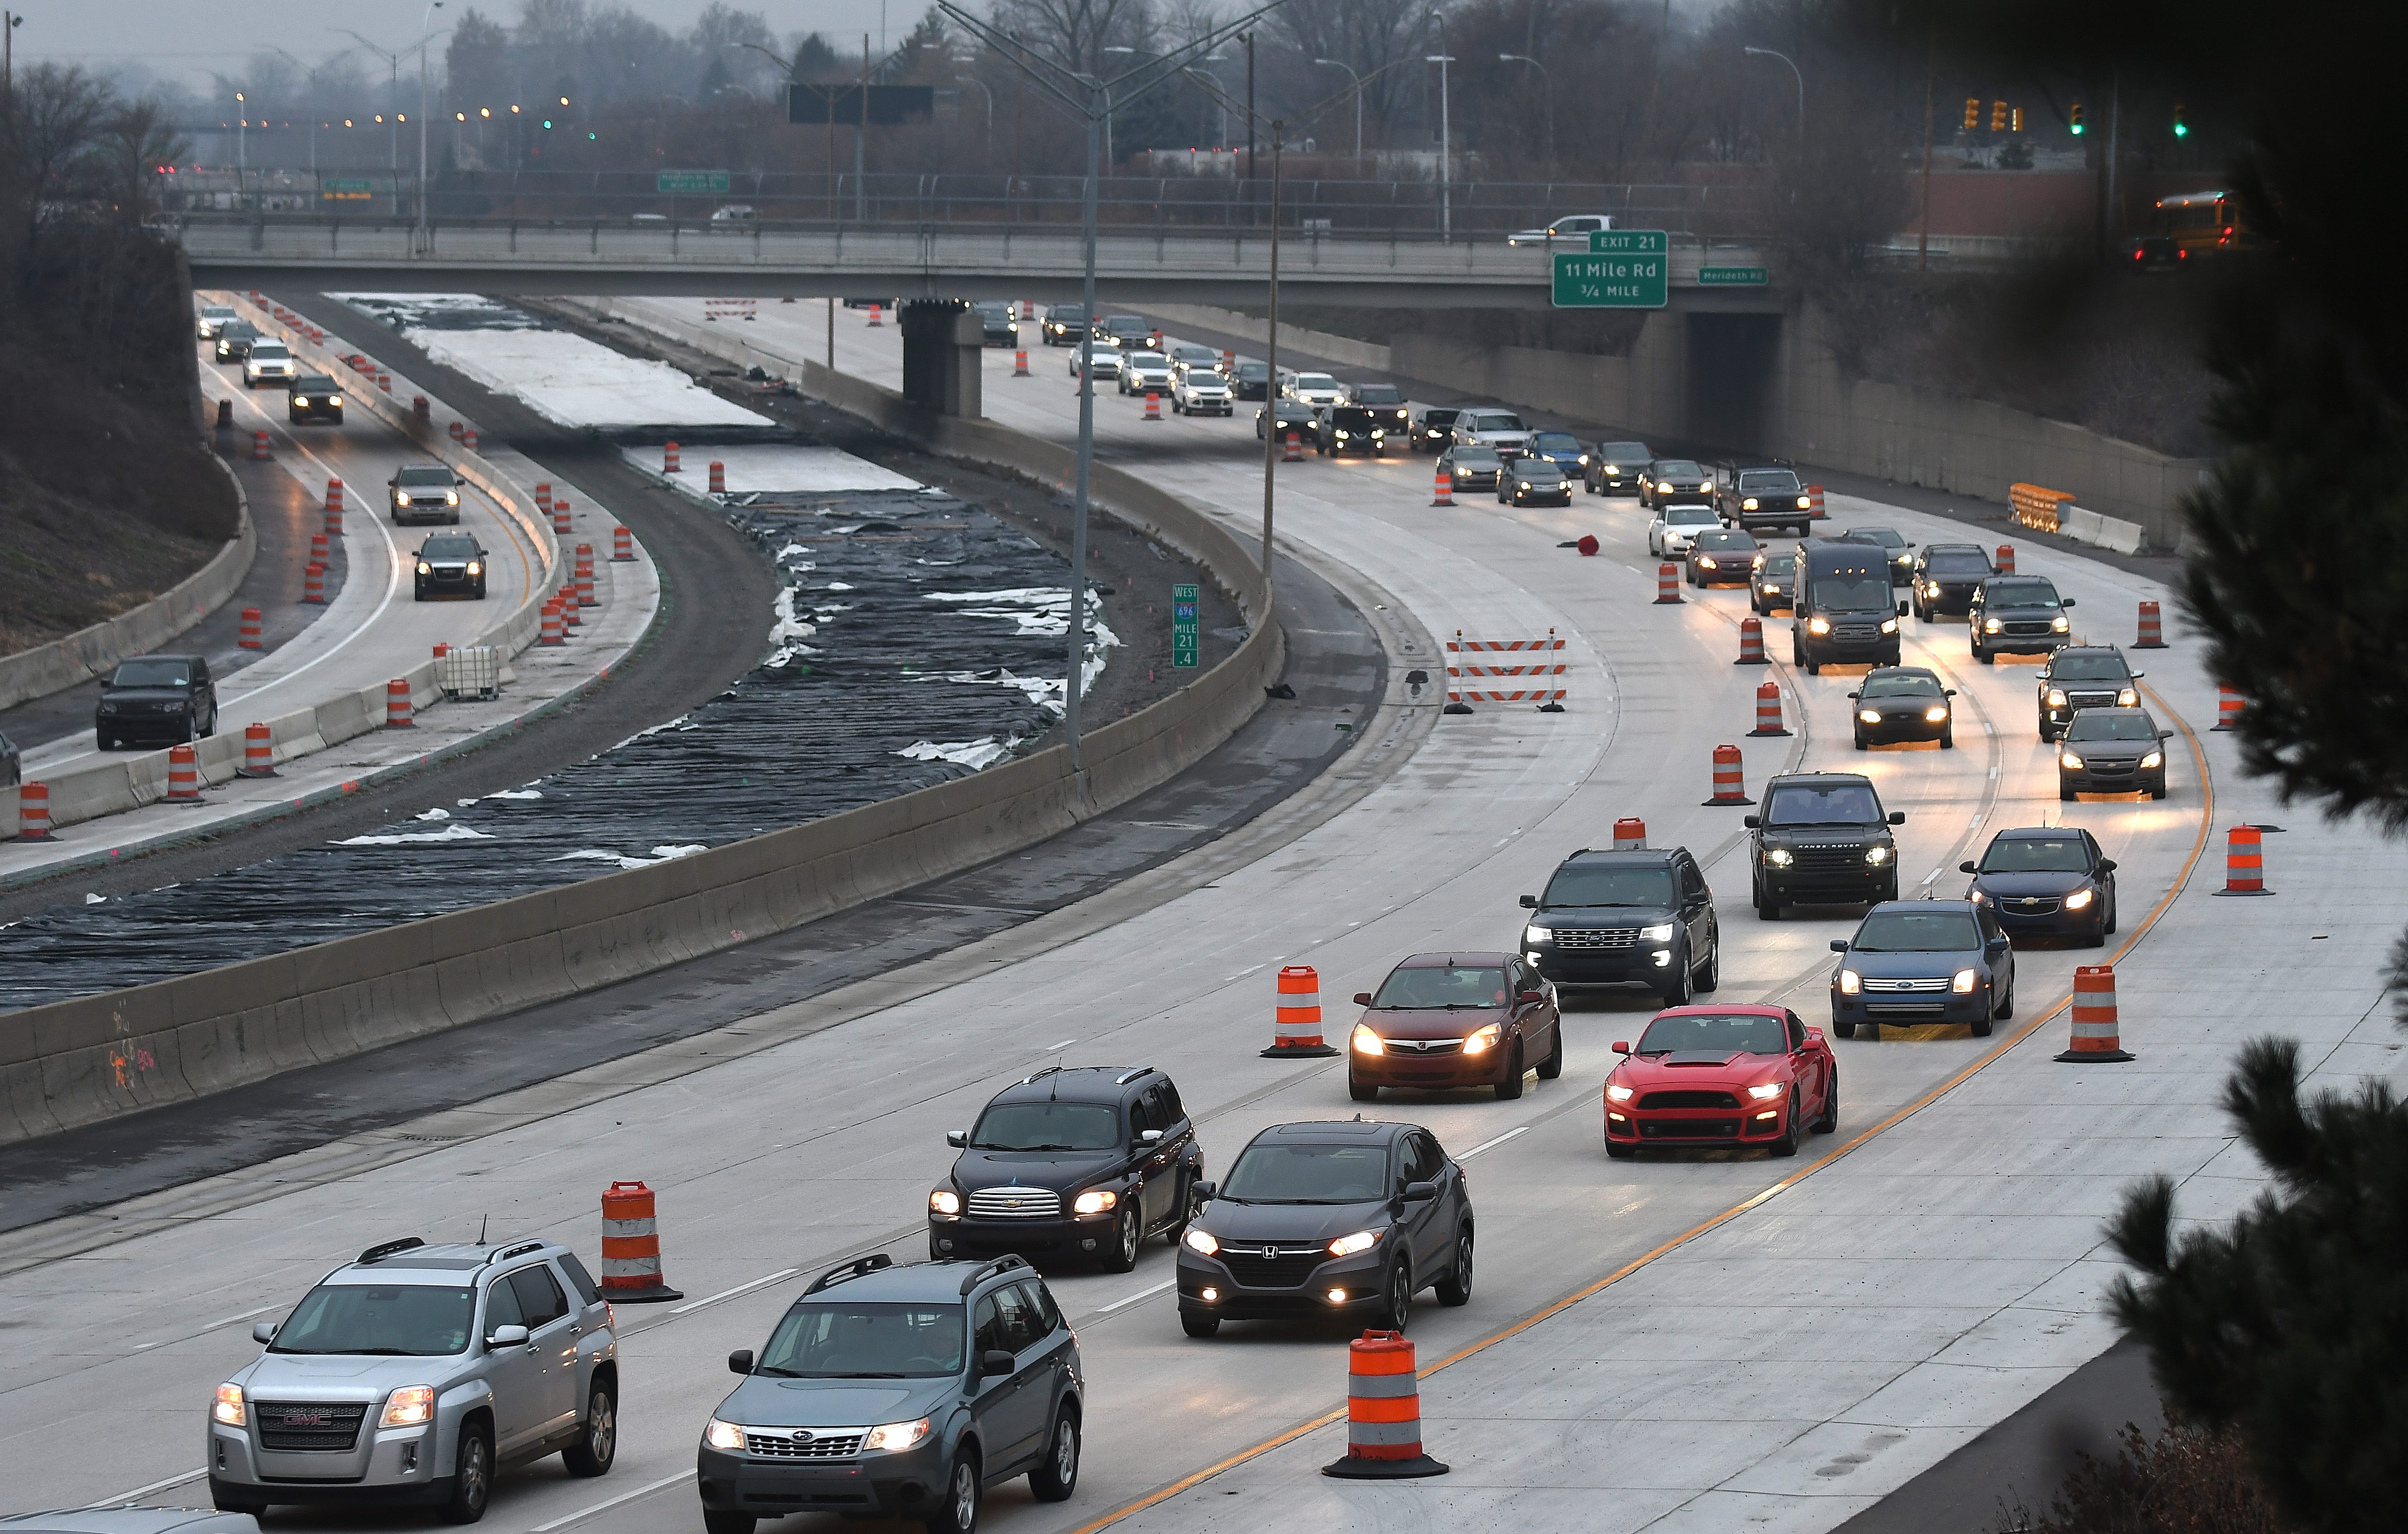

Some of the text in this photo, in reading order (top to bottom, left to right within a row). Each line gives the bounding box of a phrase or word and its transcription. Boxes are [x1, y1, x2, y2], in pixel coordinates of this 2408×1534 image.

[1601, 236, 1655, 249] EXIT 21
[1565, 263, 1656, 277] 11 Mile Rd
[1607, 285, 1639, 297] MILE
[1175, 587, 1197, 598] WEST
[1179, 606, 1193, 615] 696
[1175, 624, 1197, 633] MILE
[1179, 634, 1192, 647] 21
[284, 1414, 332, 1425] GMC
